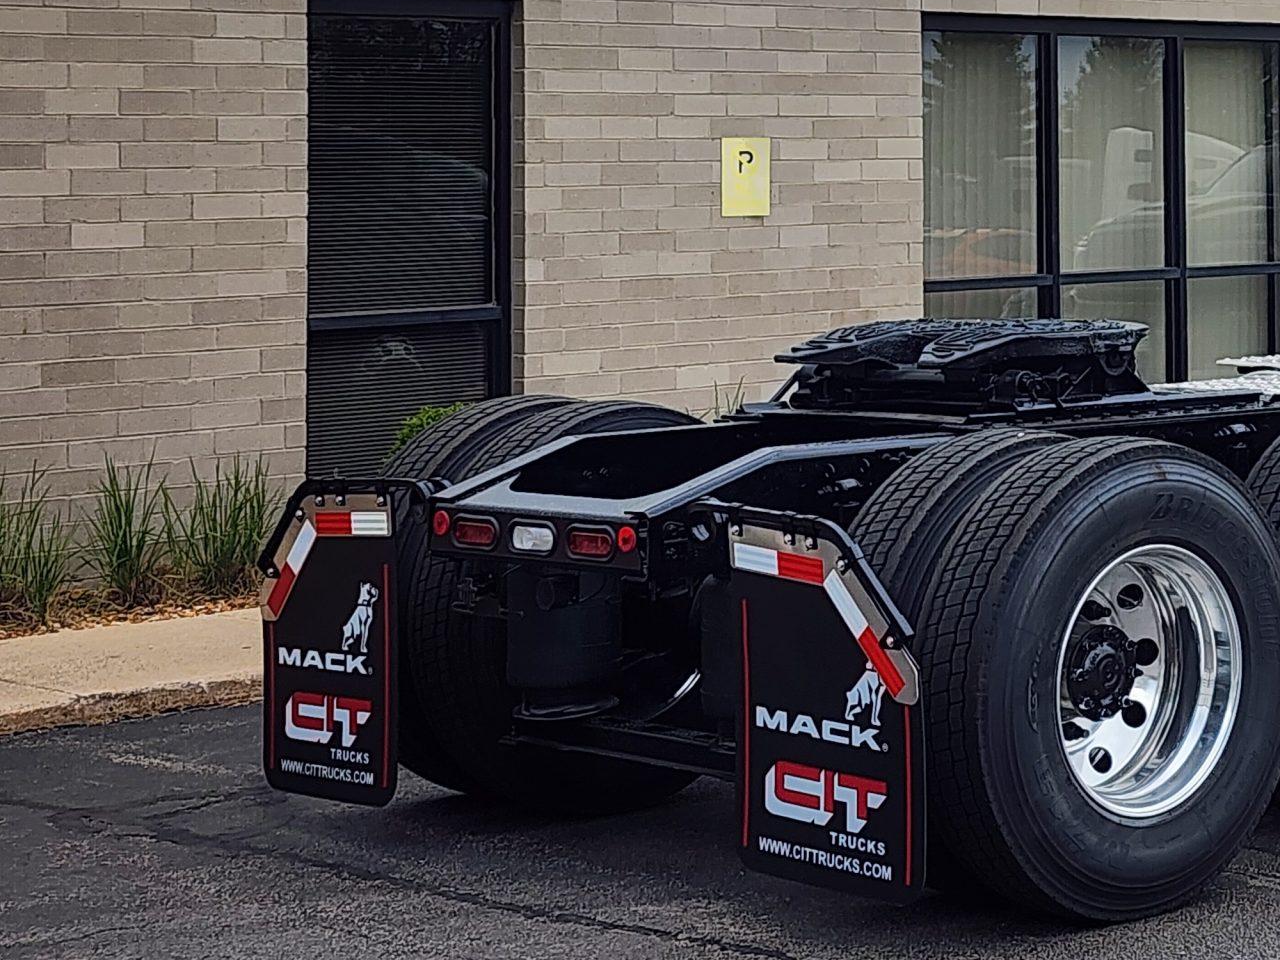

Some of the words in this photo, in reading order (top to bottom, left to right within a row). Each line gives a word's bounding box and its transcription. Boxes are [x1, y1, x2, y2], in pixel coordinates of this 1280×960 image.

[285, 691, 373, 747] CIT
[281, 759, 374, 785] WWW.CITTRUCKS.COM
[330, 748, 370, 764] TRUCKS
[765, 760, 888, 833] CIT
[759, 836, 892, 881] WWW.CITTRUCKS.COM
[830, 832, 886, 855] TRUCKS
